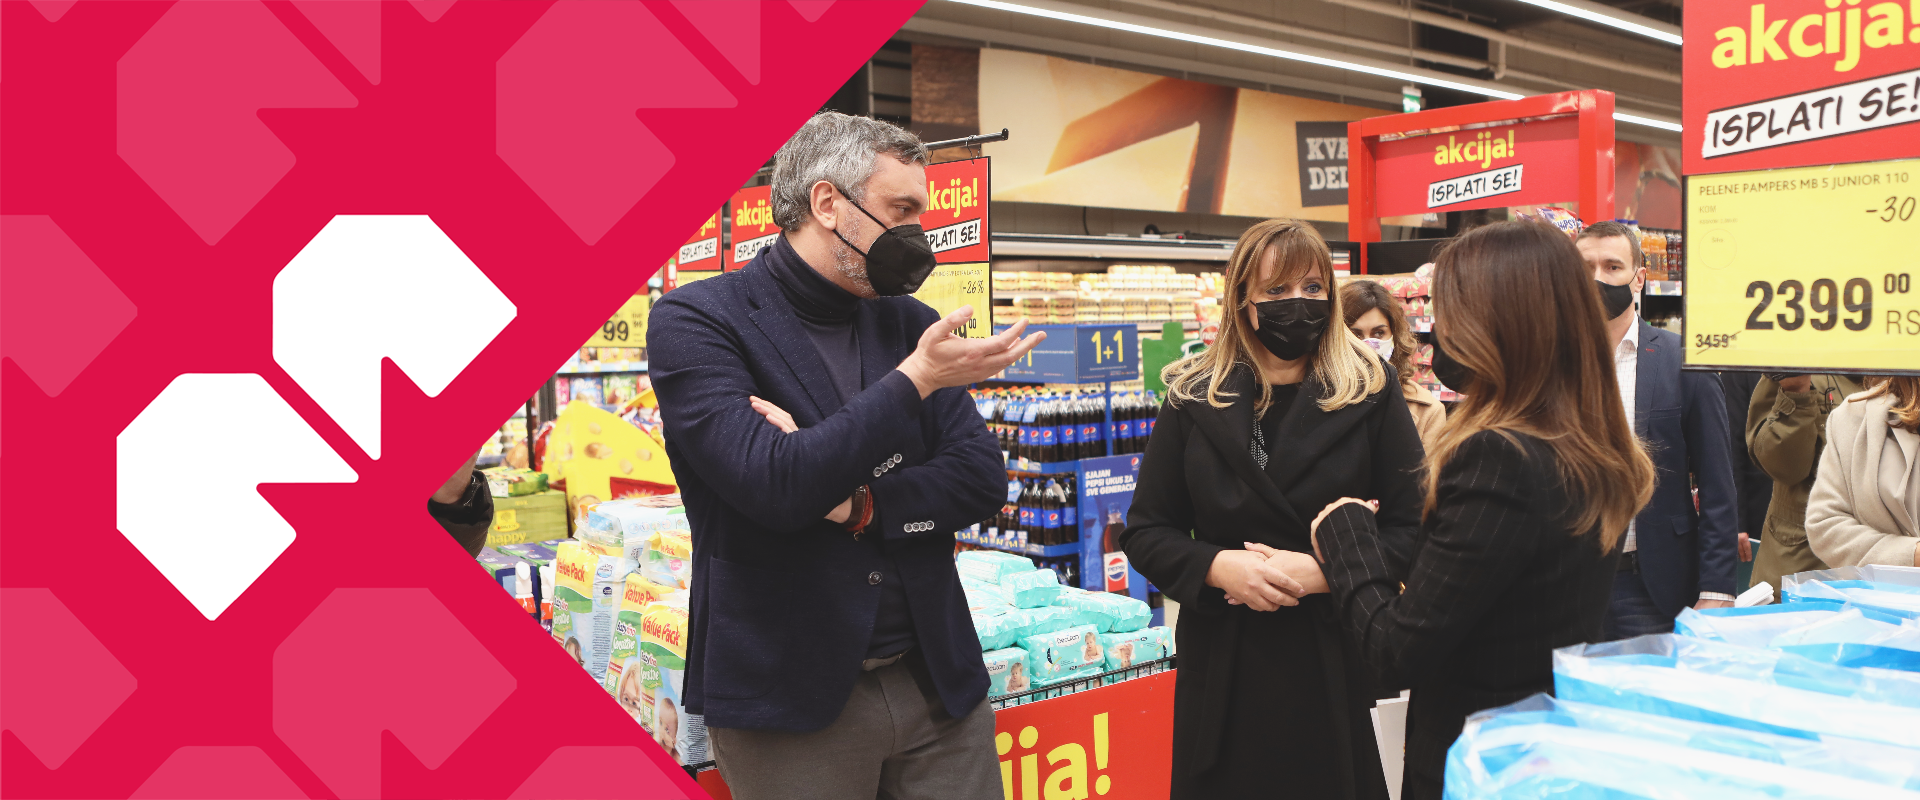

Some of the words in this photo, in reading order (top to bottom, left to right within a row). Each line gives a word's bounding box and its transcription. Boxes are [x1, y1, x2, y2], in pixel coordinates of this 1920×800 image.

[1711, 0, 1920, 72] akcija!
[1713, 95, 1843, 148] ISPLATI
[1859, 76, 1920, 122] SE!
[1434, 130, 1515, 169] akcija!
[1432, 177, 1487, 203] ISPLATI
[1492, 169, 1519, 191] SE!
[1699, 183, 1740, 196] PELENE
[1743, 180, 1797, 193] PAMPERS
[1800, 178, 1819, 189] MB
[1822, 177, 1829, 188] 5
[1832, 174, 1880, 190] JUNIOR
[1886, 172, 1909, 184] 110
[926, 177, 978, 218] kcija!
[1865, 195, 1916, 223] -30
[960, 222, 978, 243] SE!
[1883, 272, 1910, 294] 00
[1745, 277, 1873, 332] 2399
[968, 318, 977, 329] 00
[1091, 329, 1124, 364] 1+1
[1695, 333, 1729, 348] 3459
[1085, 469, 1111, 480] SJAJAN
[1085, 478, 1105, 489] PEPSI
[1105, 476, 1123, 486] UKUS
[1124, 475, 1134, 483] ZA
[1085, 487, 1099, 497] SVE
[487, 531, 527, 546] happy
[571, 562, 585, 583] Pack
[625, 583, 645, 606] Value
[643, 616, 661, 638] Value
[662, 623, 680, 646] Pack
